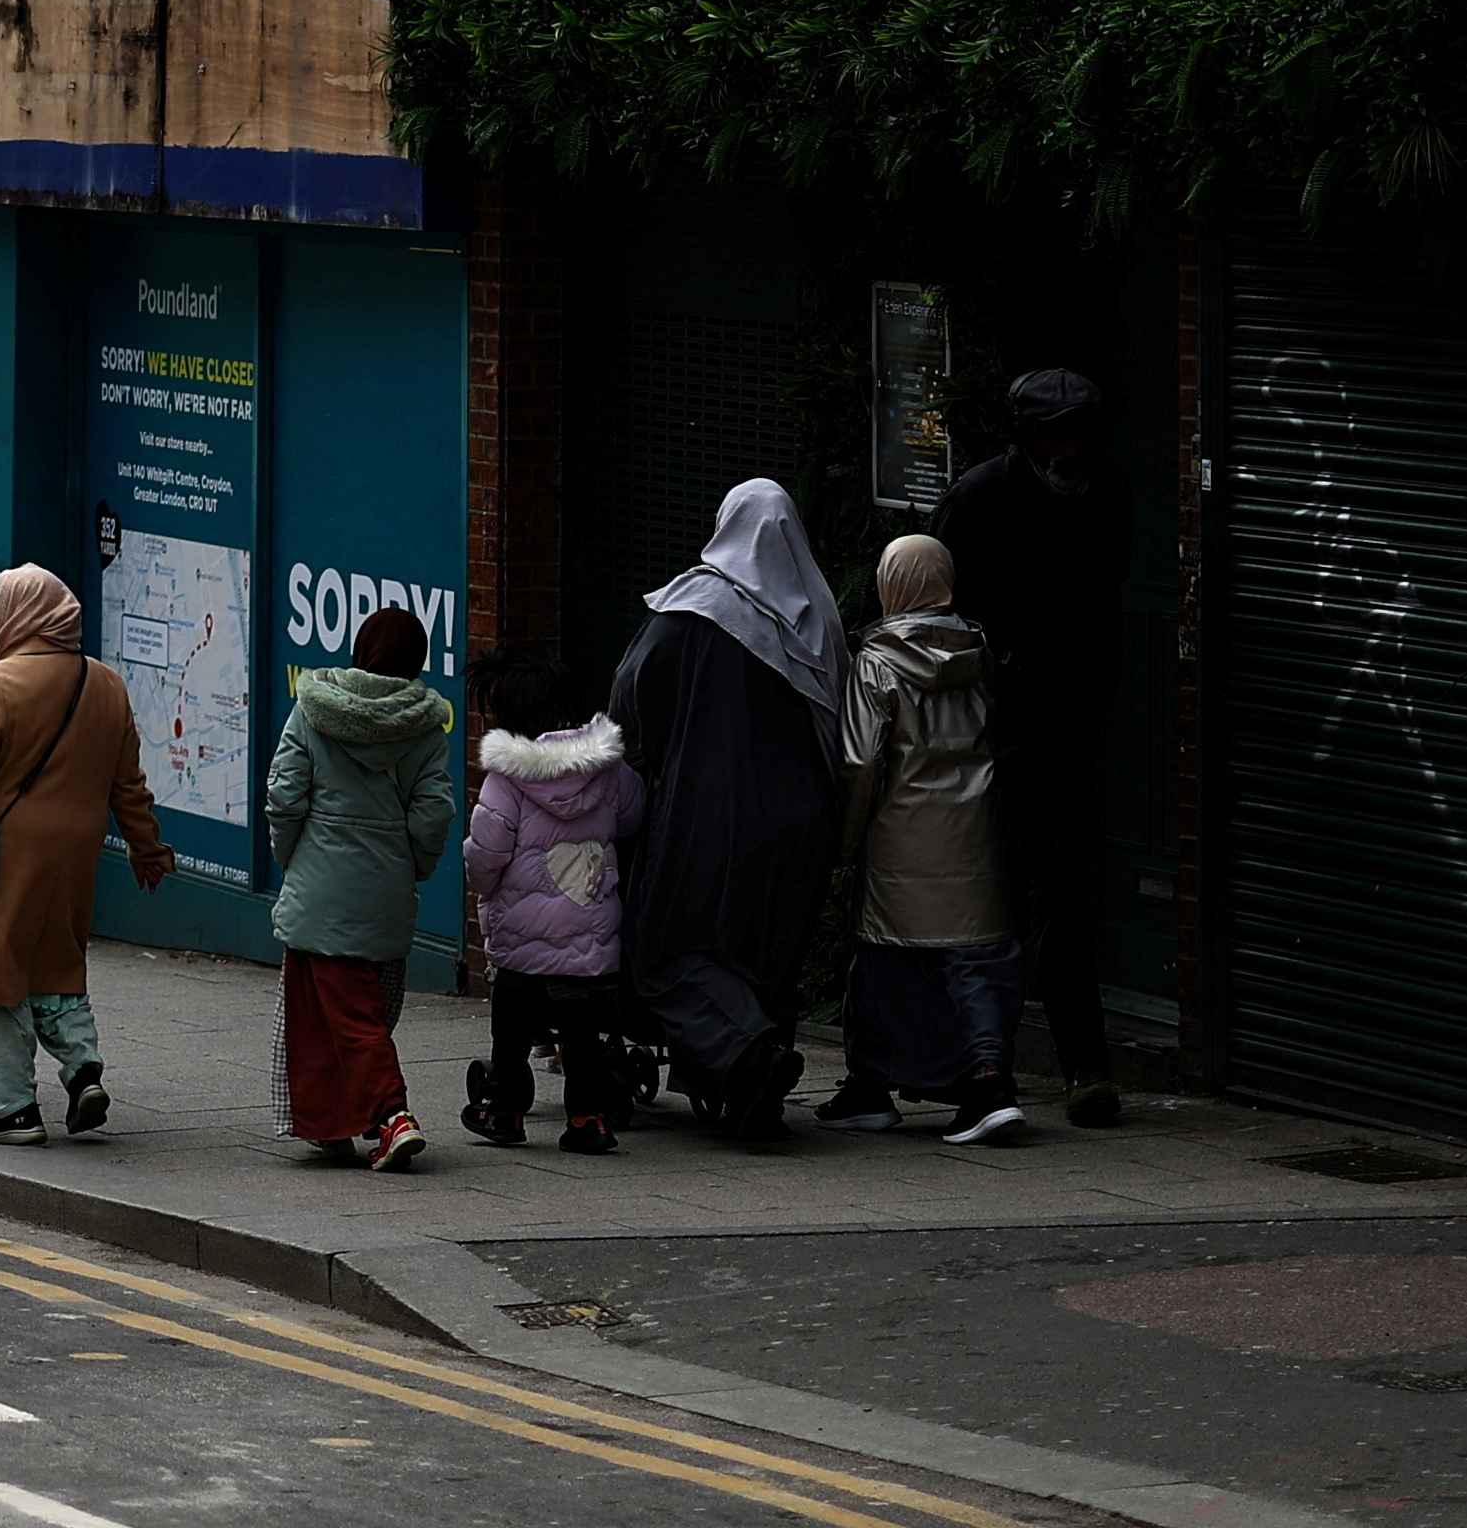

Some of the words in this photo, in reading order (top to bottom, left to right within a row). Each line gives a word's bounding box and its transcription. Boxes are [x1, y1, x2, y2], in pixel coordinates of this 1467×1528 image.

[138, 279, 218, 320] Poundland
[101, 346, 145, 374] SORRY!
[147, 351, 167, 376] WE
[170, 354, 204, 380] HAVE
[206, 358, 254, 386] CLOSED
[101, 383, 130, 404] DON'T
[133, 386, 172, 414] WORRY,
[174, 392, 205, 414] WE'RE
[207, 396, 229, 418] NOT
[140, 431, 154, 447] Visit
[155, 436, 166, 449] our
[167, 436, 184, 451] store
[117, 462, 132, 478] Unit
[133, 463, 145, 480] 140
[146, 465, 175, 488] Whitgift
[133, 485, 159, 505] Greater
[100, 516, 116, 539] 352
